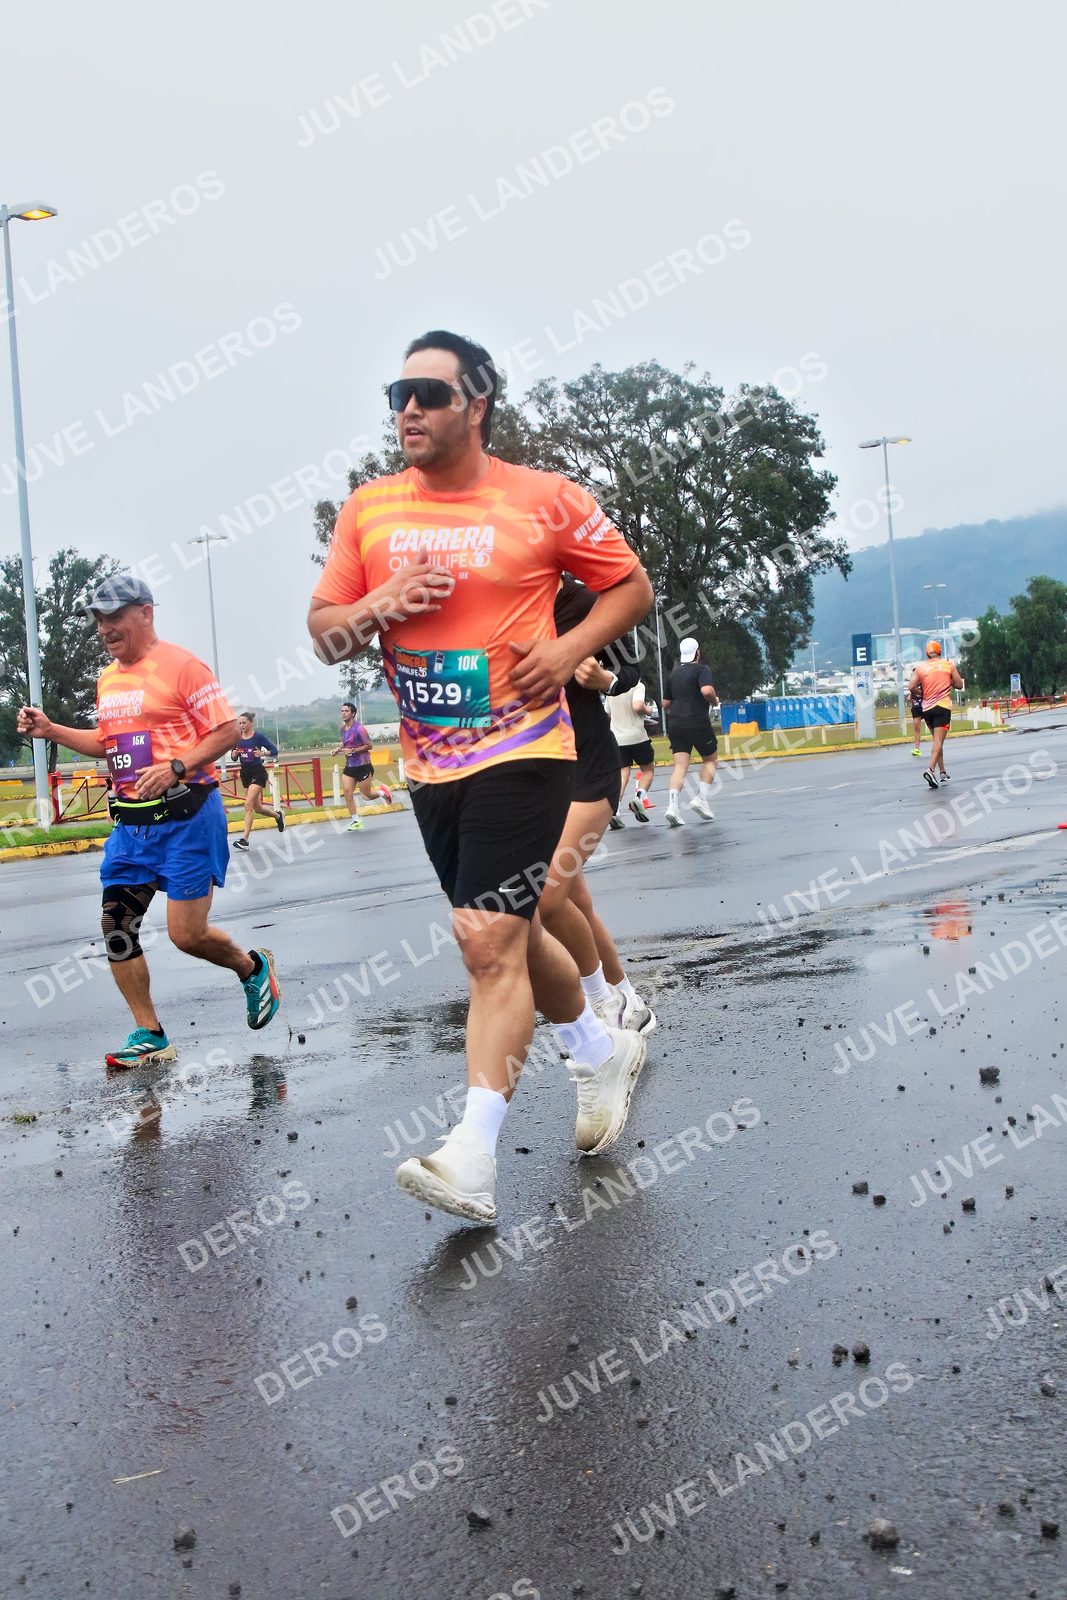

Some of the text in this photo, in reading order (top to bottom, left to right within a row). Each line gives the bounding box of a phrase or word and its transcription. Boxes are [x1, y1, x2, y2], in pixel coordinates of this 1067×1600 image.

[389, 525, 495, 552] CARRERA
[389, 552, 468, 571] OILIFE
[457, 655, 479, 671] 10K
[856, 647, 867, 662] E
[405, 679, 462, 705] 1529
[132, 734, 145, 745] 15K
[112, 753, 132, 770] 159
